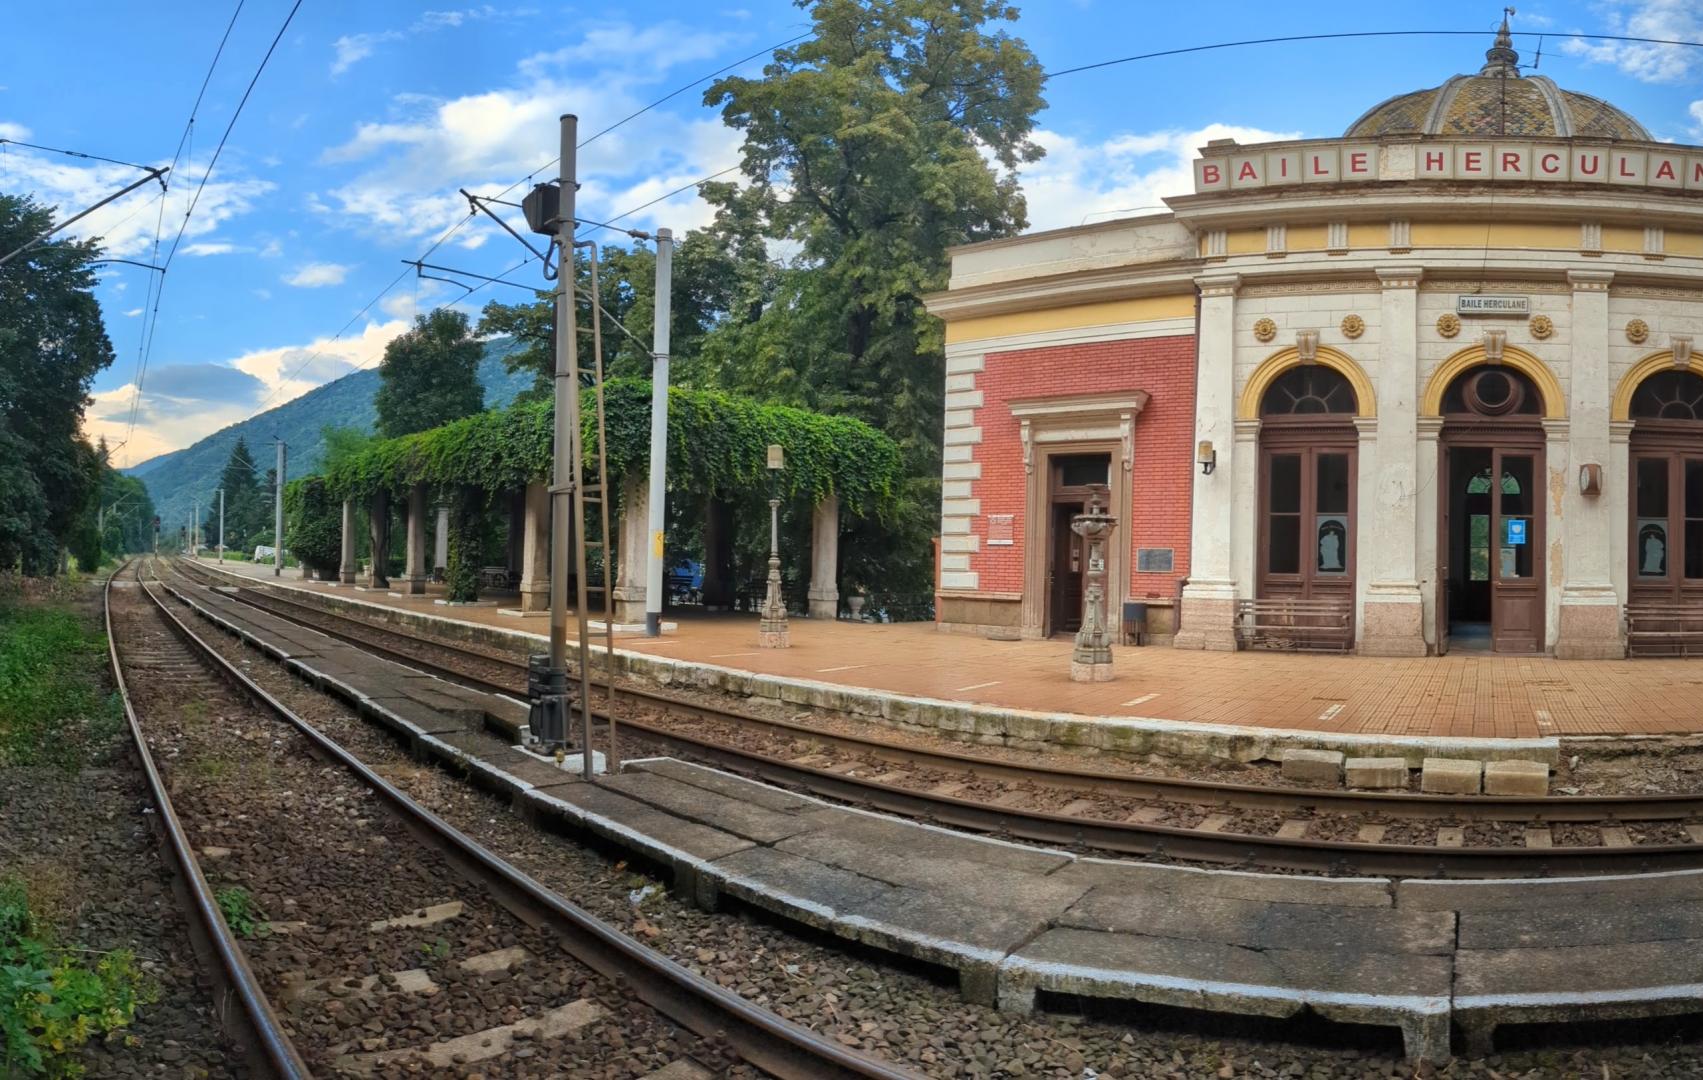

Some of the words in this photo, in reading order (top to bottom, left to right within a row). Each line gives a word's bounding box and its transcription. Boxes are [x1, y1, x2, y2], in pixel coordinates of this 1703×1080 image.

[1203, 152, 1368, 185] BAILE
[1461, 299, 1482, 309] BAILE
[1483, 299, 1527, 310] HERCULANE
